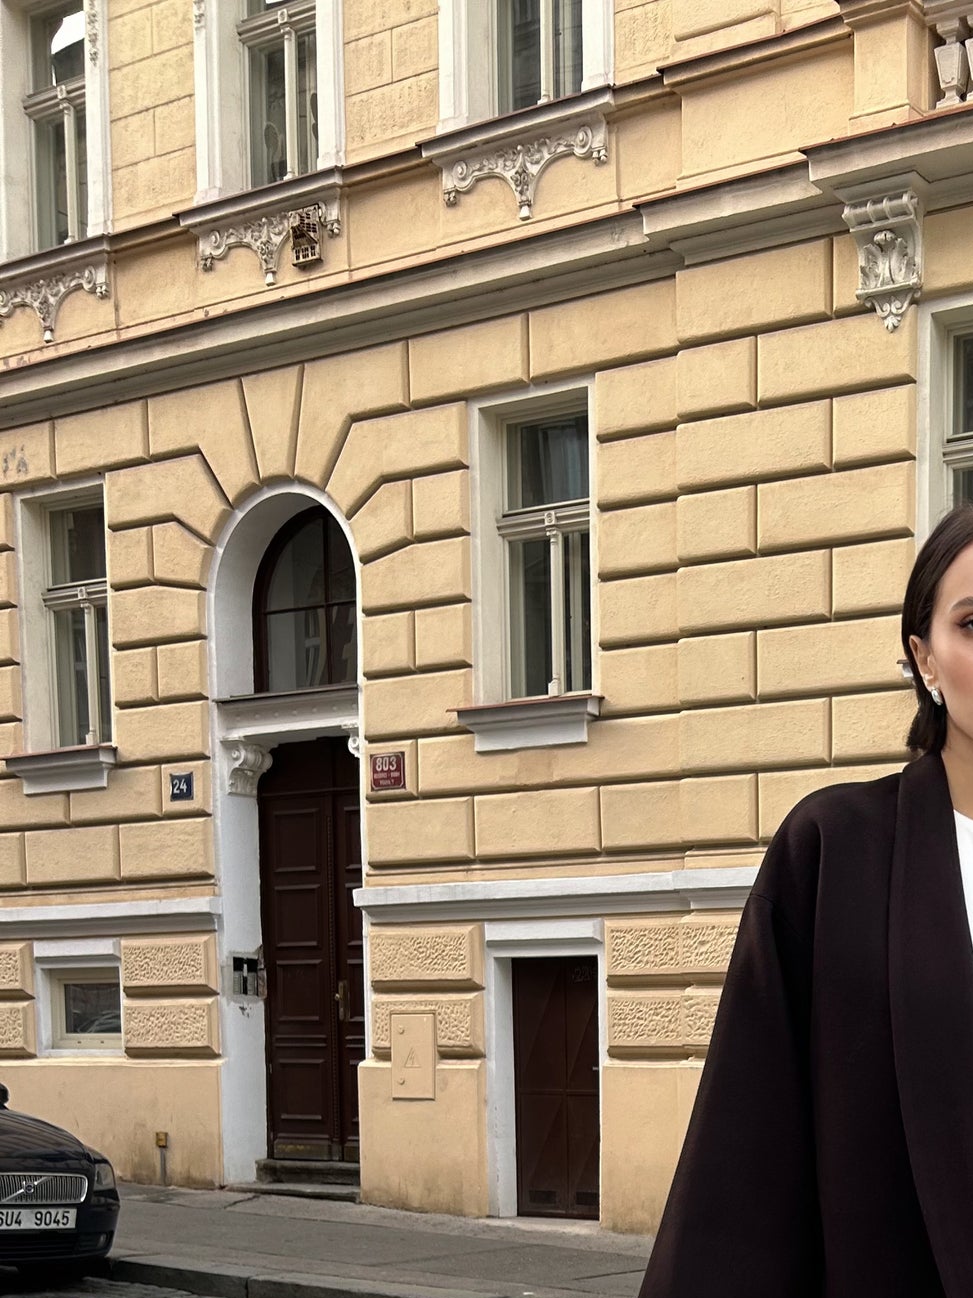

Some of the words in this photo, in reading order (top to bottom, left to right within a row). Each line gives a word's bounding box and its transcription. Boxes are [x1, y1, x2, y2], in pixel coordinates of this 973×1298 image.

[375, 756, 397, 771] 803
[172, 778, 187, 794] 24
[34, 1210, 70, 1227] 9045
